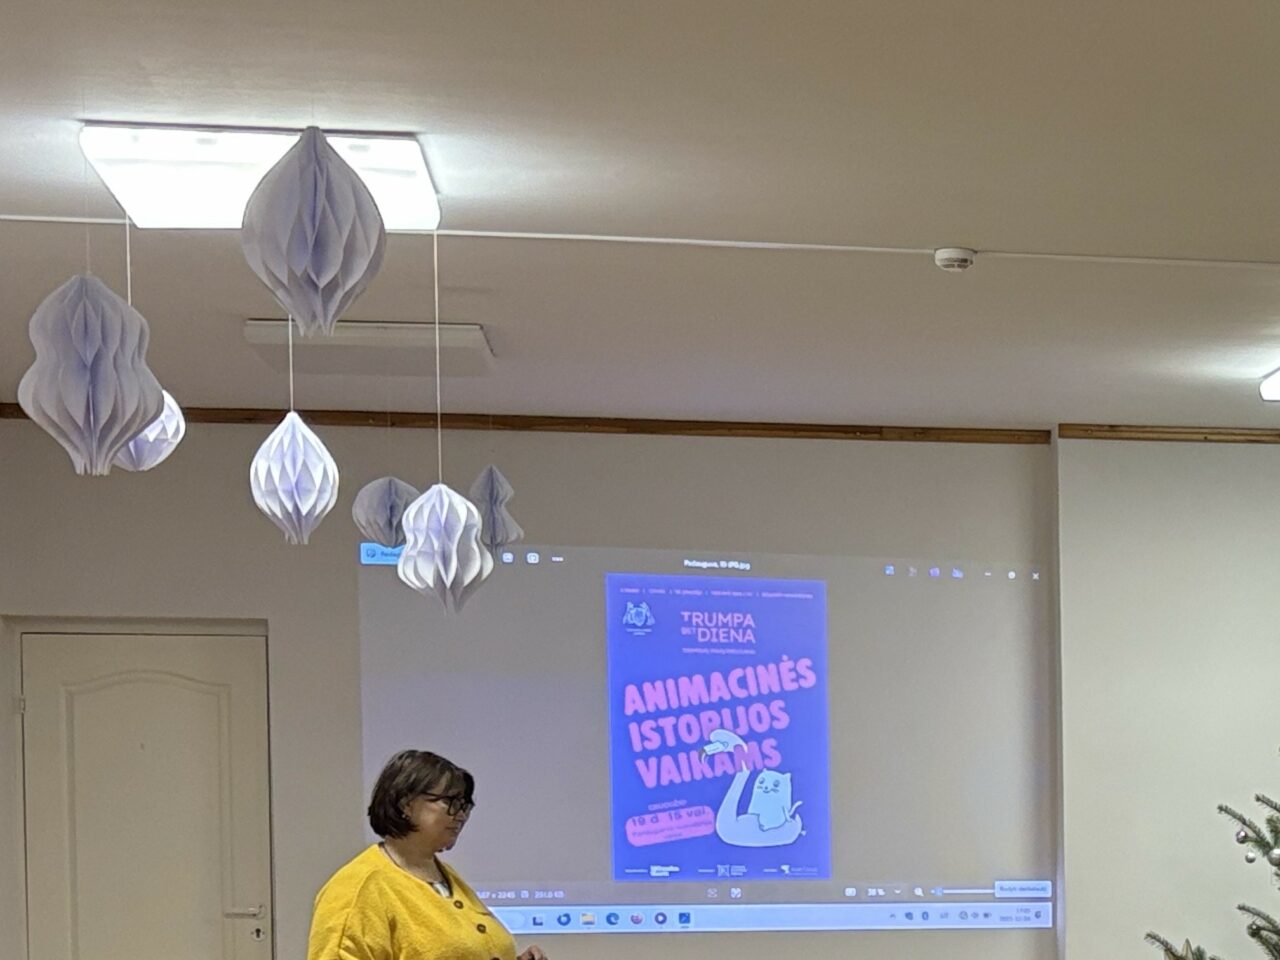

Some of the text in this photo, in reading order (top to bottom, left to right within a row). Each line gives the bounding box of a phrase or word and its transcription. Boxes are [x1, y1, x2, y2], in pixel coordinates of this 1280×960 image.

[681, 611, 756, 628] TRUMPA
[697, 628, 756, 643] DIENA
[624, 654, 817, 716] ANIMACINĖS
[628, 699, 790, 752] ISTORIJOS
[635, 738, 782, 788] VAIKAMS
